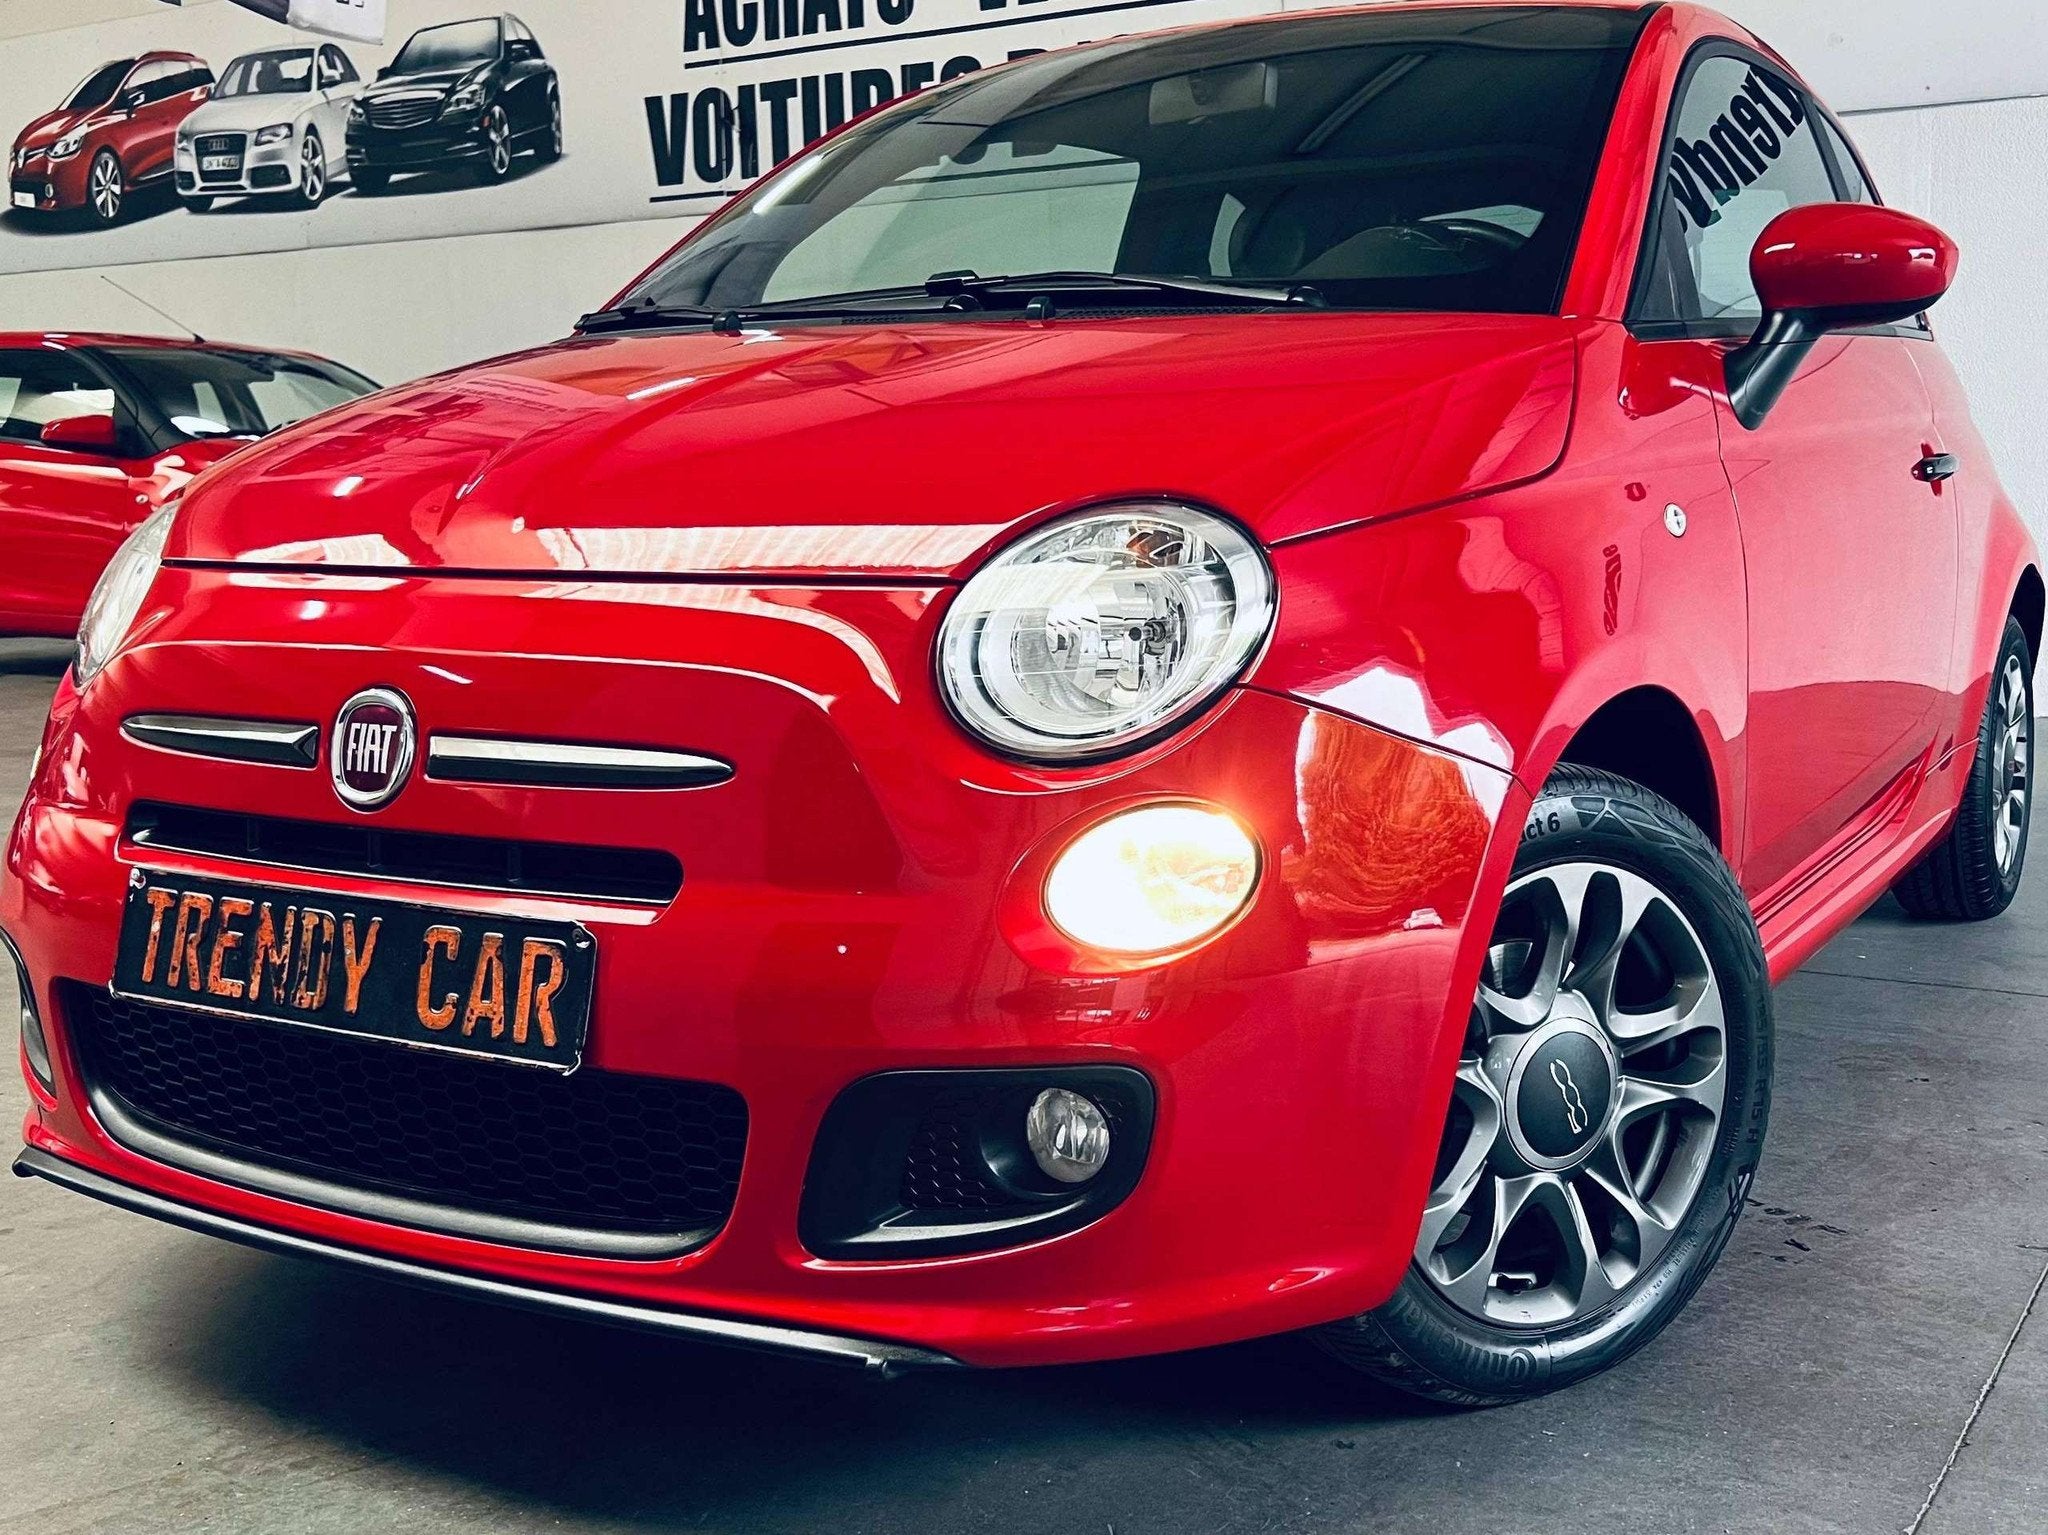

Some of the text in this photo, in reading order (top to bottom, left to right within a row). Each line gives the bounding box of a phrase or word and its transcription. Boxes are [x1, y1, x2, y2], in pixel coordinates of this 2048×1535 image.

[346, 722, 398, 775] FIAT
[1546, 811, 1561, 833] 6
[141, 887, 567, 1047] TRENDY CAR
